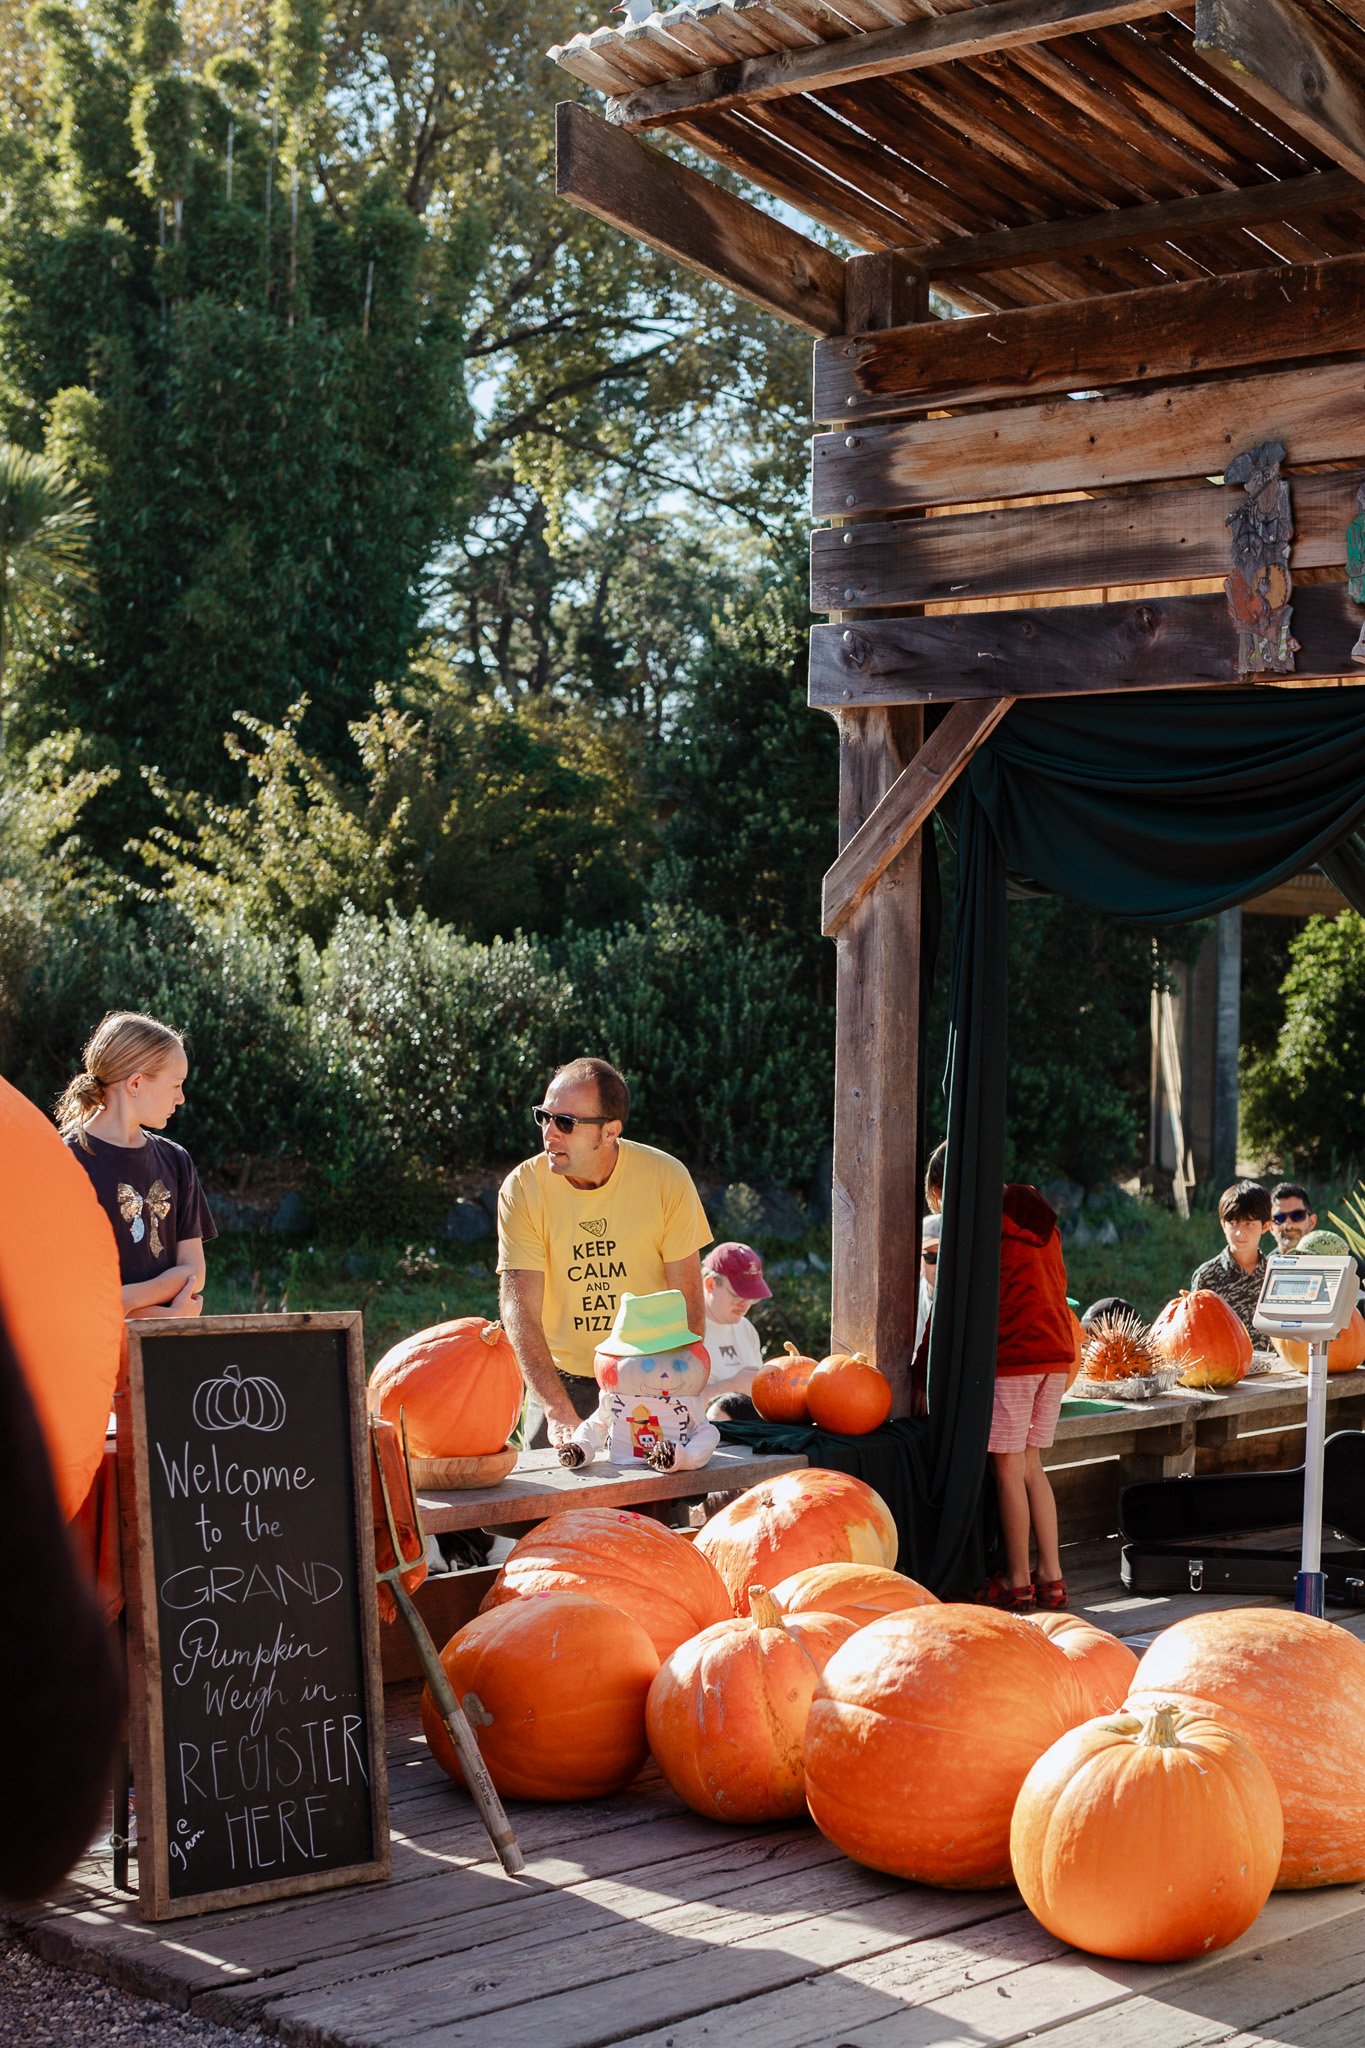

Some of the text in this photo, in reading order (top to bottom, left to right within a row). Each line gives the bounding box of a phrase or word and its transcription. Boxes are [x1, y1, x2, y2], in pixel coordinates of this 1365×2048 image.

[567, 1262, 627, 1281] CALM
[573, 1240, 616, 1260] KEEP
[582, 1294, 617, 1311] EAT
[586, 1282, 610, 1292] AND
[573, 1316, 613, 1331] PIZZ
[156, 1441, 315, 1499] Welcome
[195, 1501, 283, 1552] to the
[160, 1562, 343, 1610] GRAND
[173, 1618, 328, 1686] Pumpkin
[203, 1669, 288, 1736] Weigh
[179, 1715, 369, 1804] REGISTER
[225, 1794, 328, 1869] HERE
